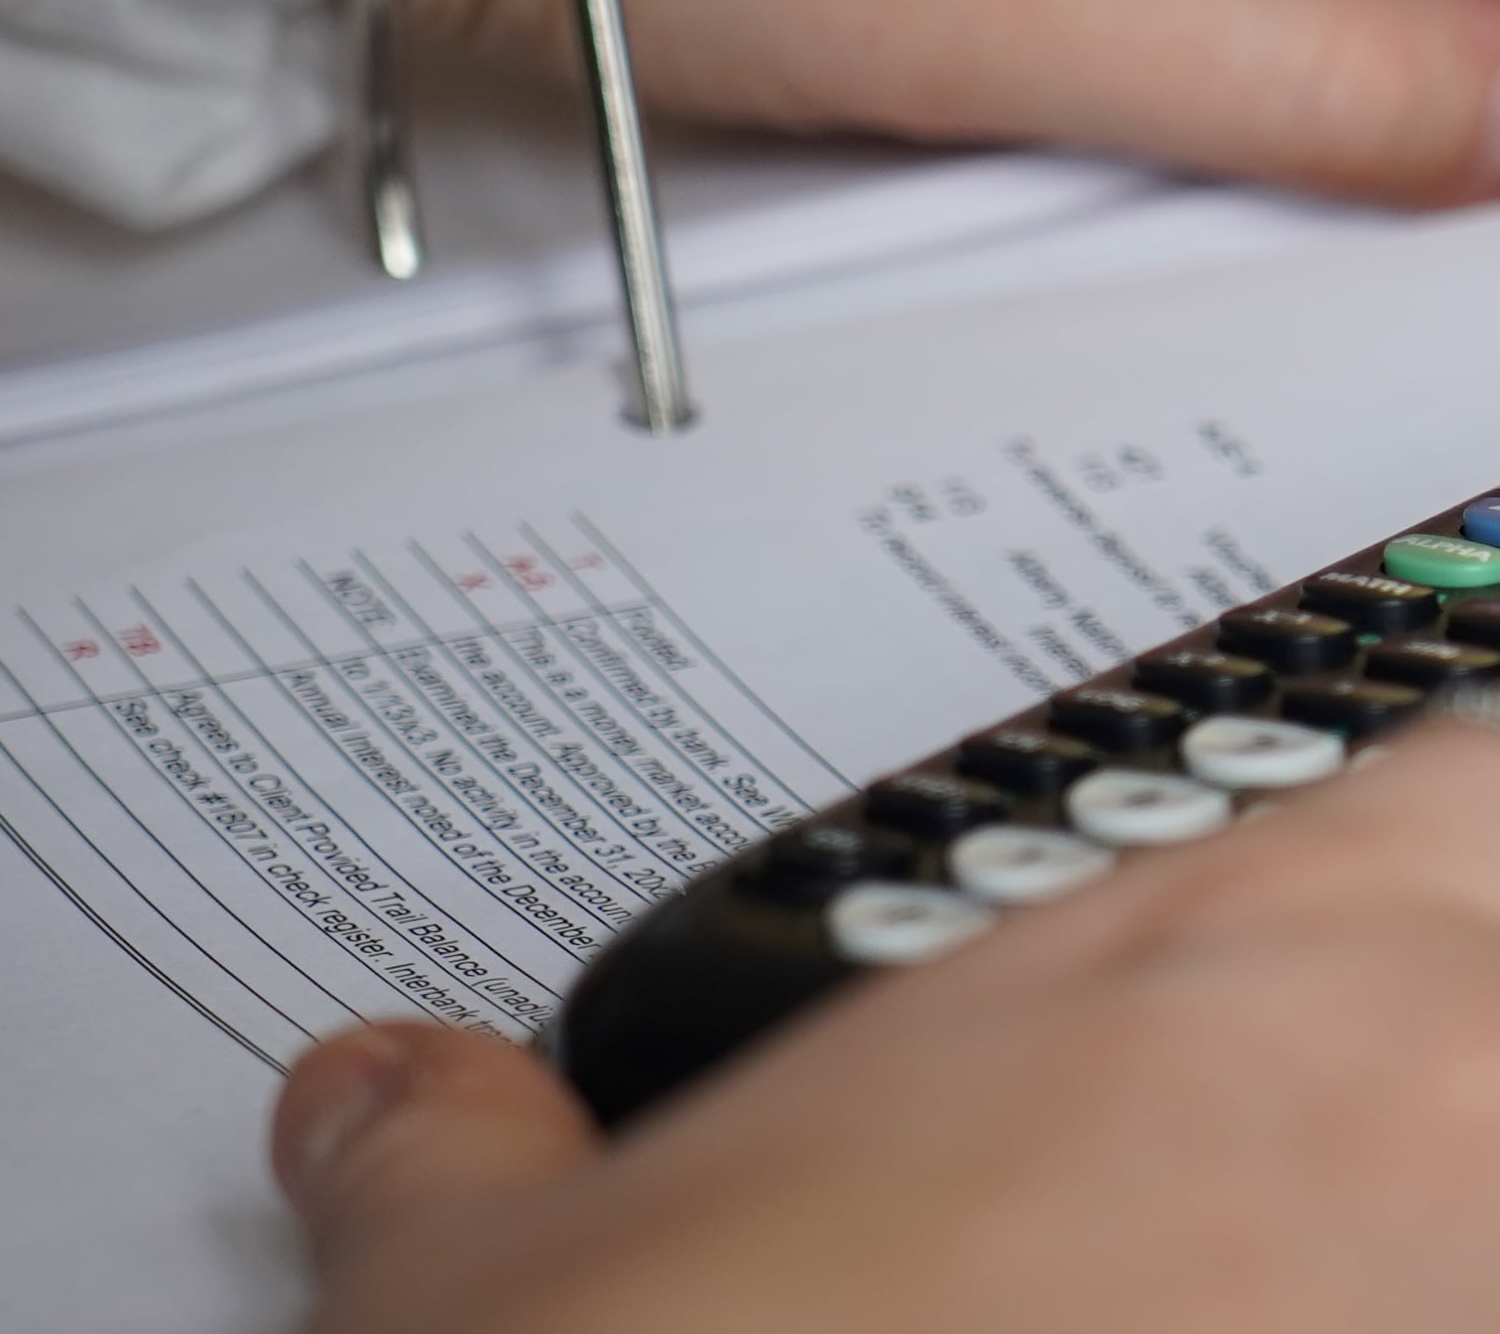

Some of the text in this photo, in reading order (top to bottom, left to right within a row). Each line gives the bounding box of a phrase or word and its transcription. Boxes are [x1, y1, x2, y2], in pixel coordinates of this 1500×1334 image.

[1393, 536, 1492, 563] ALPHA
[288, 670, 603, 953] Annual Interest noted of the December
[338, 656, 372, 681] to
[425, 748, 464, 777] No
[451, 774, 525, 832] activity
[508, 830, 541, 851] in
[528, 848, 571, 877] the
[396, 646, 497, 736] Examined
[476, 733, 518, 763] the
[506, 760, 607, 848] December
[592, 843, 638, 870] 31,
[450, 637, 493, 669] the
[550, 740, 658, 819] Approved
[631, 816, 669, 839] by
[656, 837, 698, 863] the
[503, 625, 557, 668] This
[576, 701, 648, 757] money
[632, 756, 713, 814] market
[557, 617, 662, 708] Confirmed
[650, 704, 684, 730] by
[722, 772, 772, 809] See
[113, 697, 160, 739] See
[147, 737, 212, 791] check
[198, 790, 269, 842] #1807
[246, 842, 279, 862] in
[266, 862, 334, 911] check
[316, 906, 396, 964] register.
[383, 961, 481, 1024] Interbank
[172, 690, 554, 1028] Agrees to Client Provided Trail Balance (unadju
